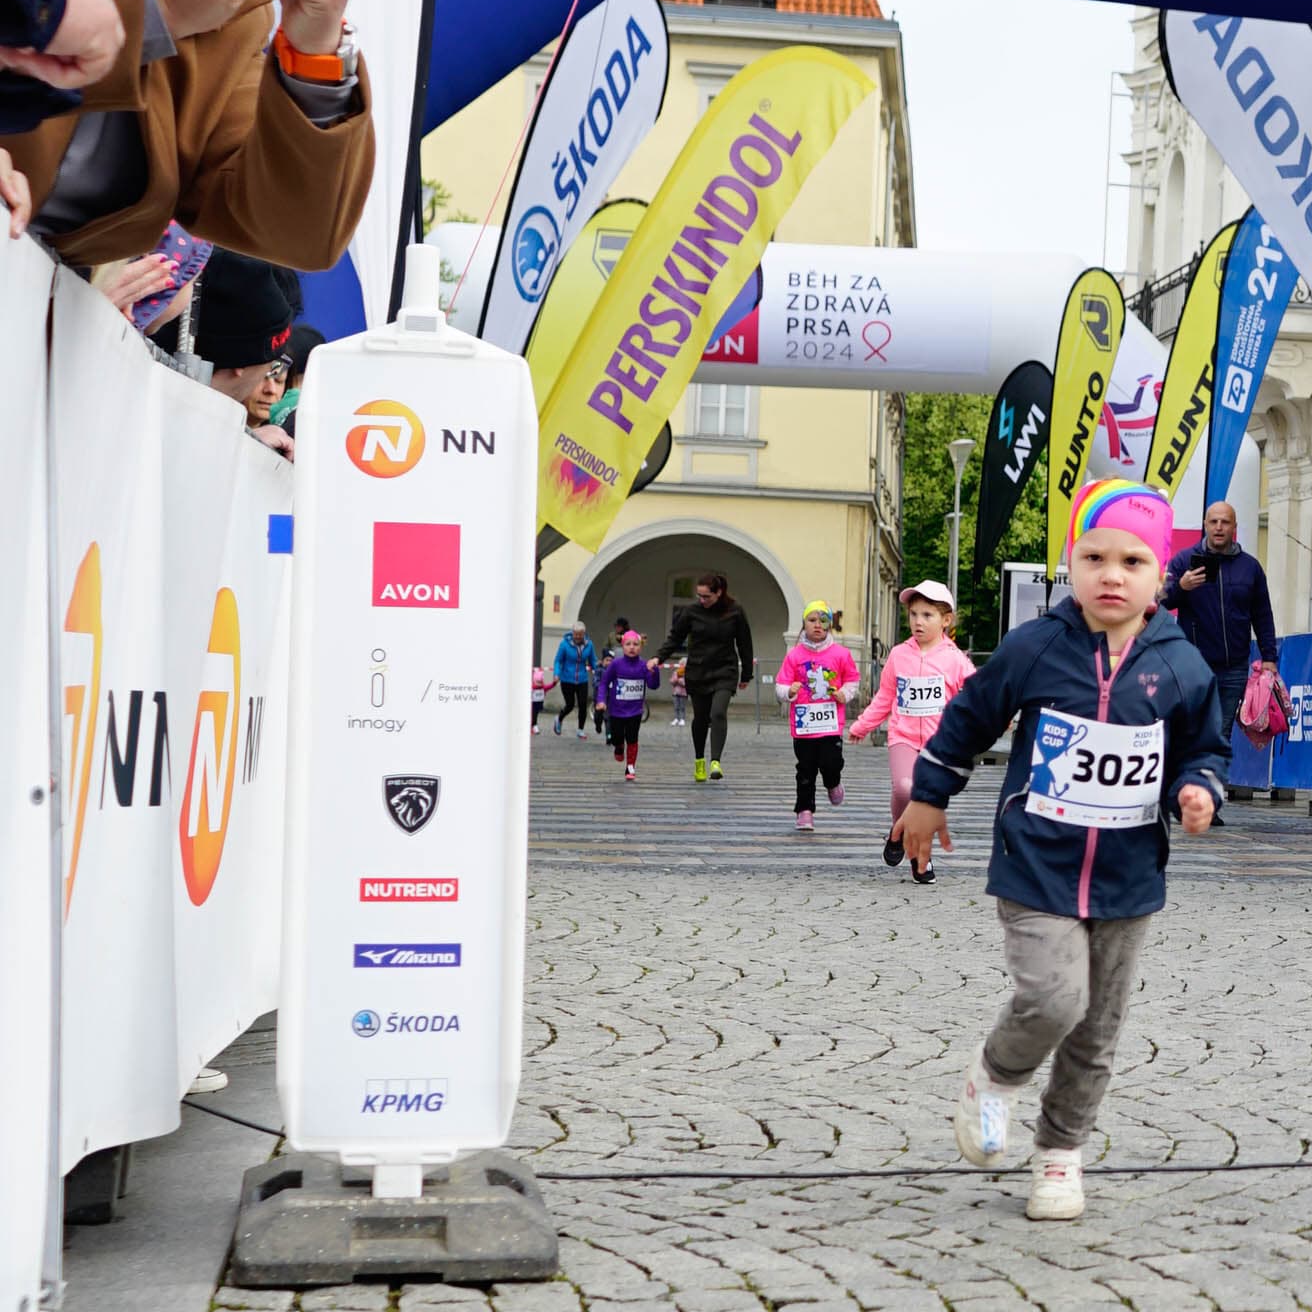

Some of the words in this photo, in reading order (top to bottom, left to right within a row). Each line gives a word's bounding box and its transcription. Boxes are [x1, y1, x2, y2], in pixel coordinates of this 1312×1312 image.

[552, 15, 653, 221] ŠKODA
[587, 112, 802, 436] PERSKINDOL
[787, 269, 838, 289] BĚH
[850, 275, 883, 291] ZA
[786, 293, 892, 315] ZDRAVÁ
[786, 317, 851, 337] PRSA
[785, 340, 854, 361] 2024
[1158, 356, 1216, 486] RUNT
[441, 429, 495, 455] NN
[1058, 371, 1104, 501] RUNTO
[554, 433, 620, 486] PERSKINDOL
[380, 583, 450, 602] AVON
[438, 683, 478, 693] Powered
[438, 693, 450, 703] by
[453, 694, 478, 702] MVM
[909, 686, 942, 701] 3178
[347, 715, 407, 732] innogy
[809, 710, 835, 722] 3051
[1043, 723, 1068, 737] KIDS
[1042, 735, 1064, 748] CUP
[1072, 748, 1160, 787] 3022
[364, 882, 456, 898] NUTREND
[385, 1012, 461, 1033] ŠKODA
[362, 1092, 445, 1114] KPMG
